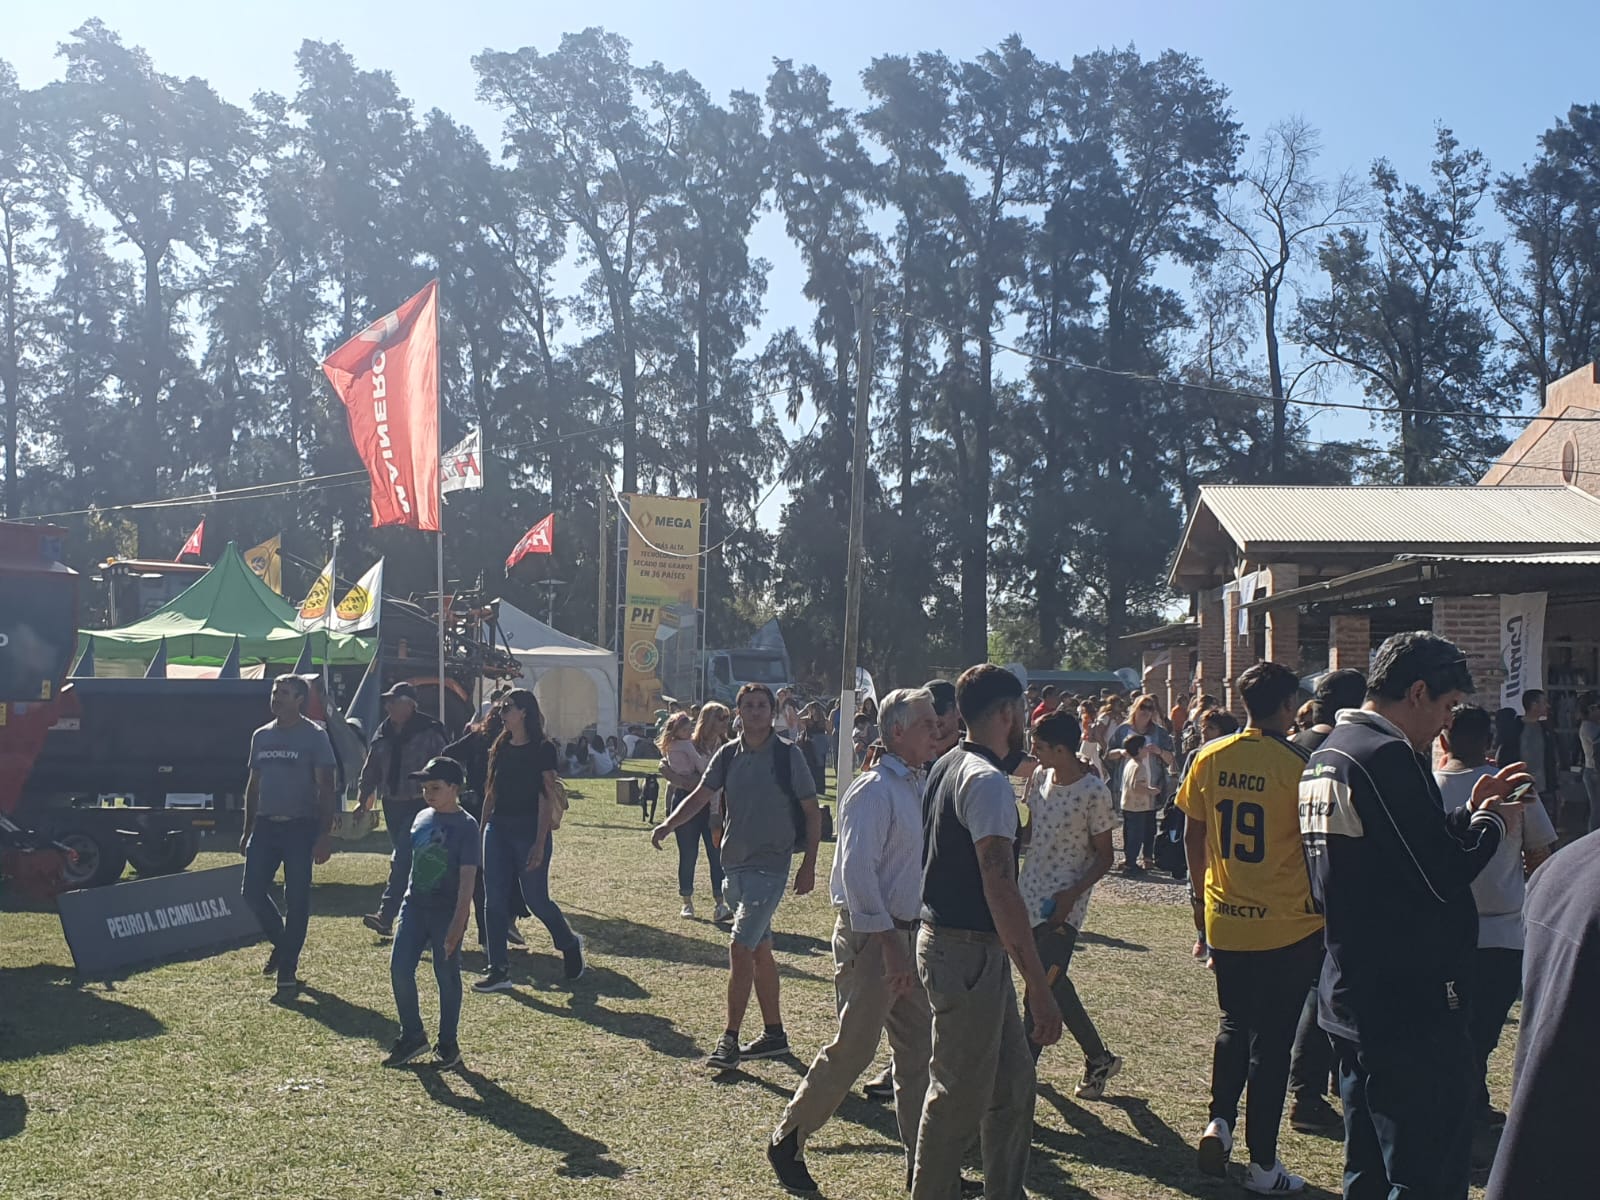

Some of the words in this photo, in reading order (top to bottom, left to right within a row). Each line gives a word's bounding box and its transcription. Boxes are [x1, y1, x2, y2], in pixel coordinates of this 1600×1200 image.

[655, 516, 692, 529] MEGA
[631, 607, 655, 623] PH
[1218, 771, 1266, 792] BARCO
[1215, 799, 1265, 864] 19
[106, 913, 146, 939] PEDRO
[143, 911, 159, 932] A.
[155, 908, 171, 929] DI
[167, 900, 212, 927] CAMILLO
[208, 897, 232, 918] S.A.
